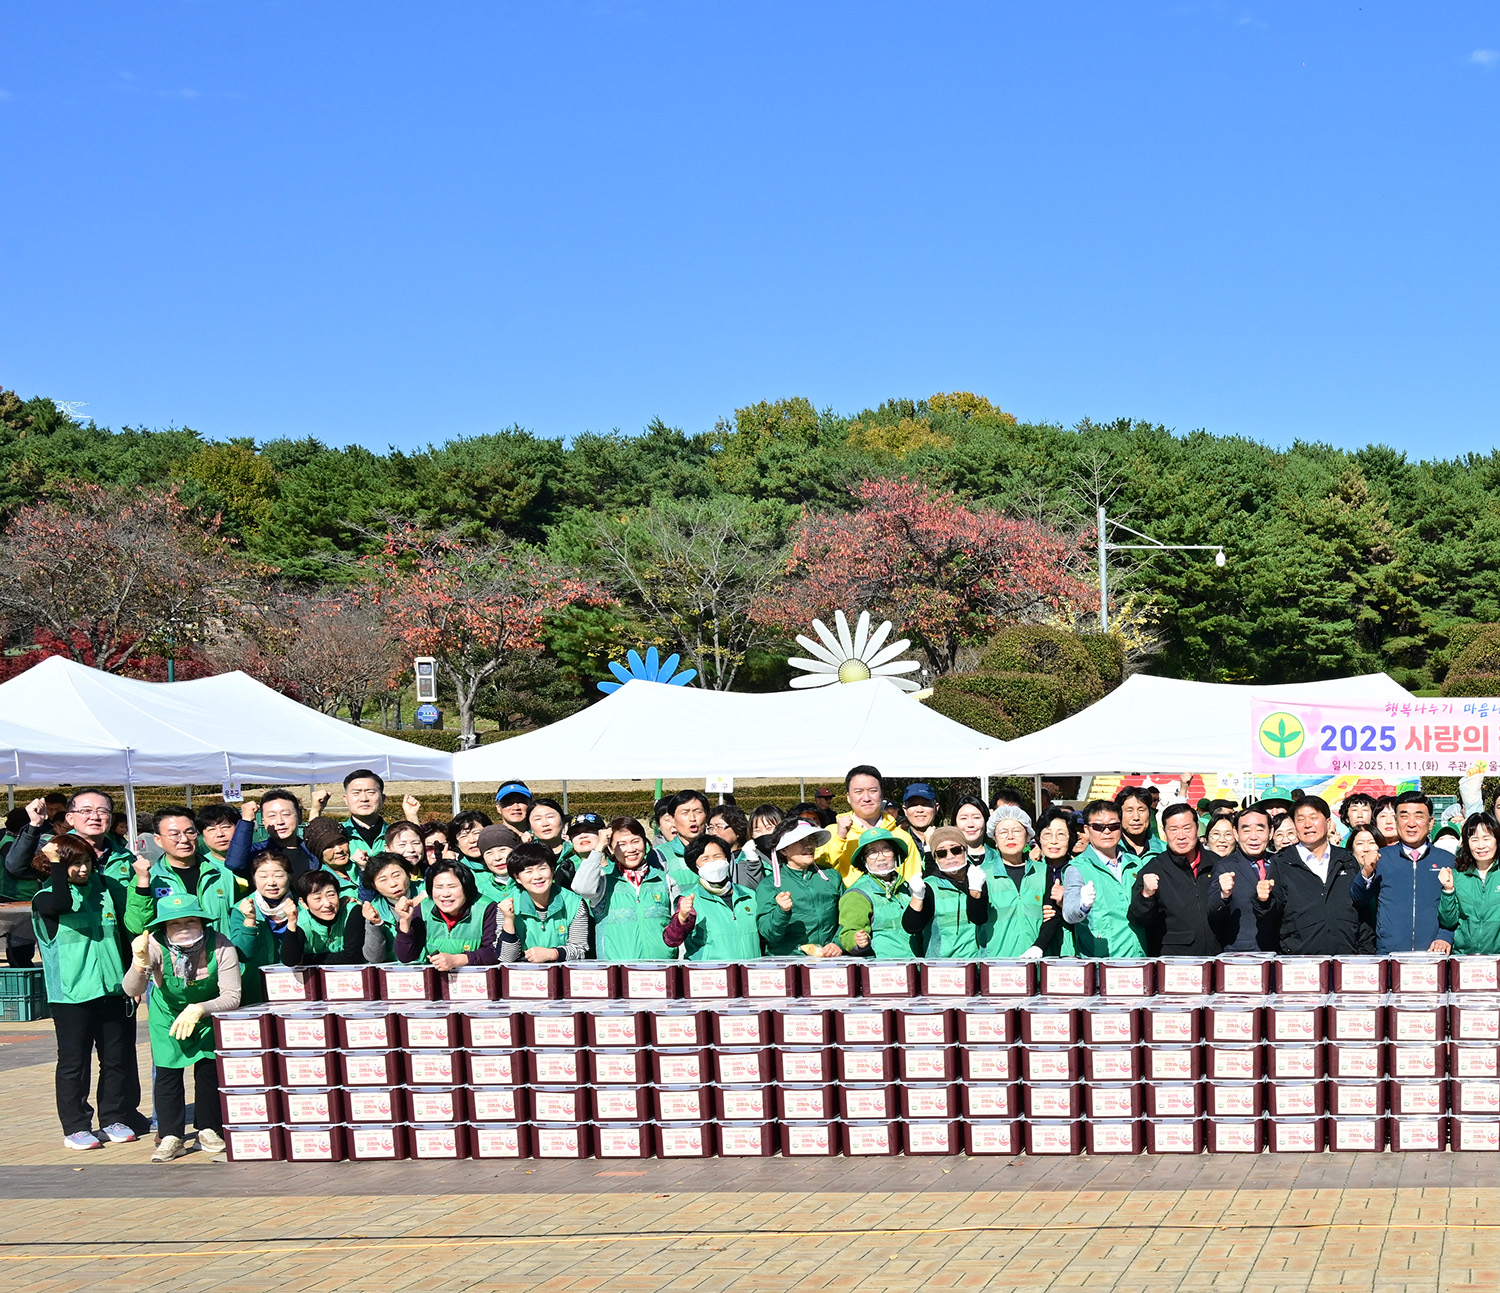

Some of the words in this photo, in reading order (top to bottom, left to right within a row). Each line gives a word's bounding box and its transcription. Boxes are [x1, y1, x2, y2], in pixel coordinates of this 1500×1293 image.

[1385, 702, 1453, 717] 행복나누기
[1321, 725, 1397, 752] 2025
[1405, 725, 1489, 752] 사랑의
